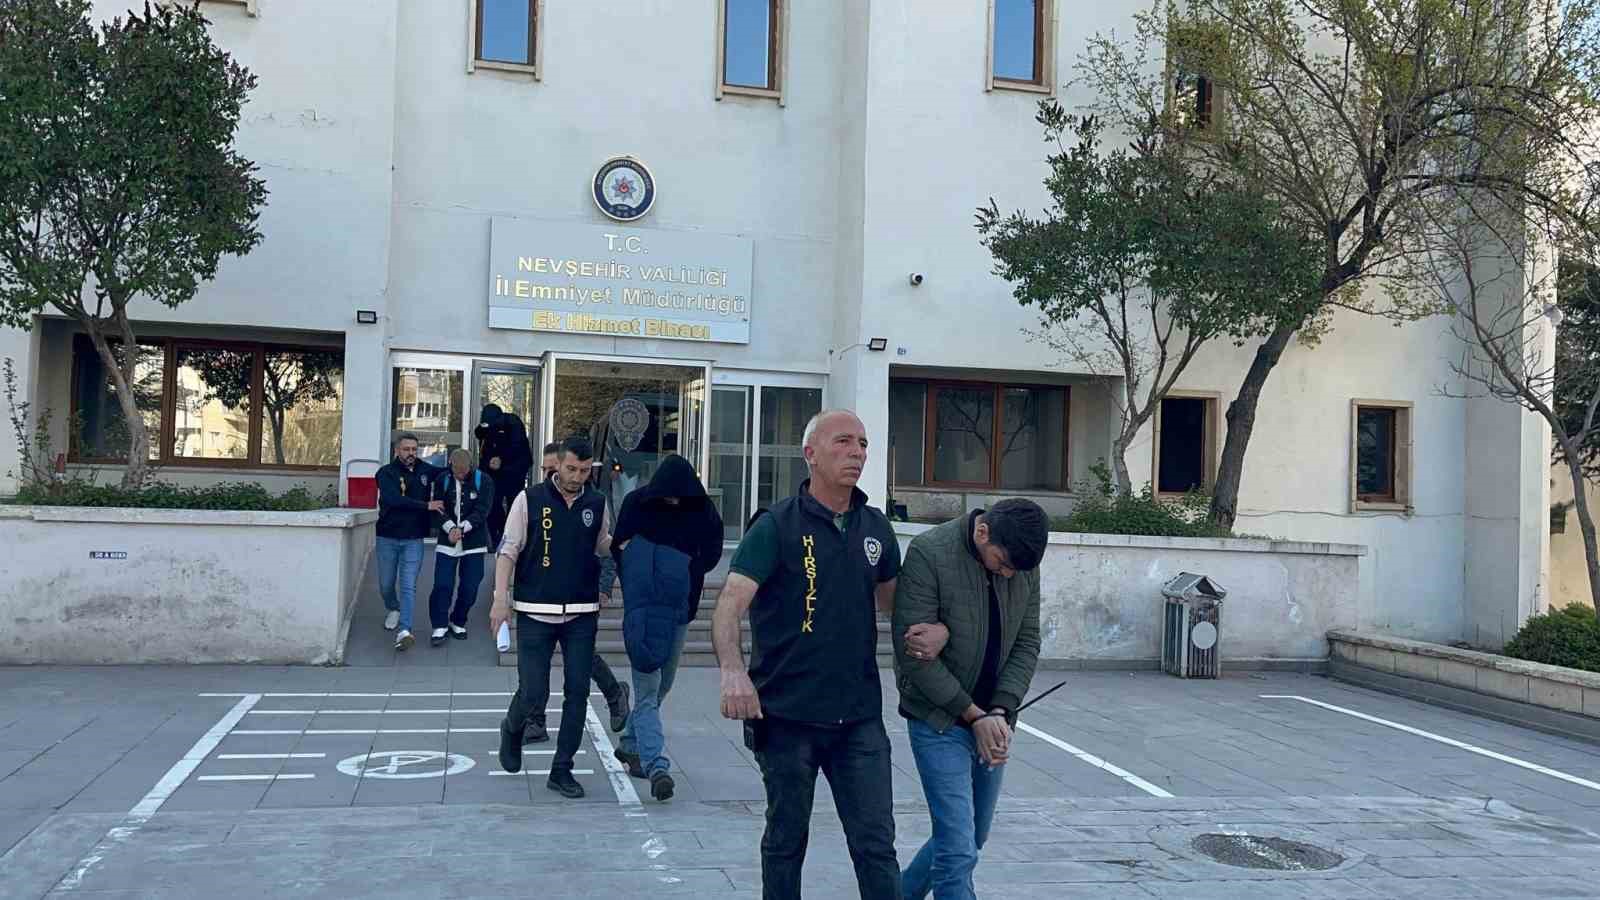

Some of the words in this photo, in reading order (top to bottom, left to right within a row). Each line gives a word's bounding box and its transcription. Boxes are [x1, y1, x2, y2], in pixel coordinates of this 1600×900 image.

[603, 233, 648, 253] T.C.
[517, 256, 632, 279] NEVŞEHİR
[496, 274, 509, 296] İl
[515, 280, 612, 305] Emniyet
[623, 287, 746, 315] Müdürlüğü
[532, 311, 561, 330] Ek
[567, 312, 640, 335] Hizmet
[645, 318, 711, 340] Binası
[802, 535, 817, 632] HIRSIZLIK
